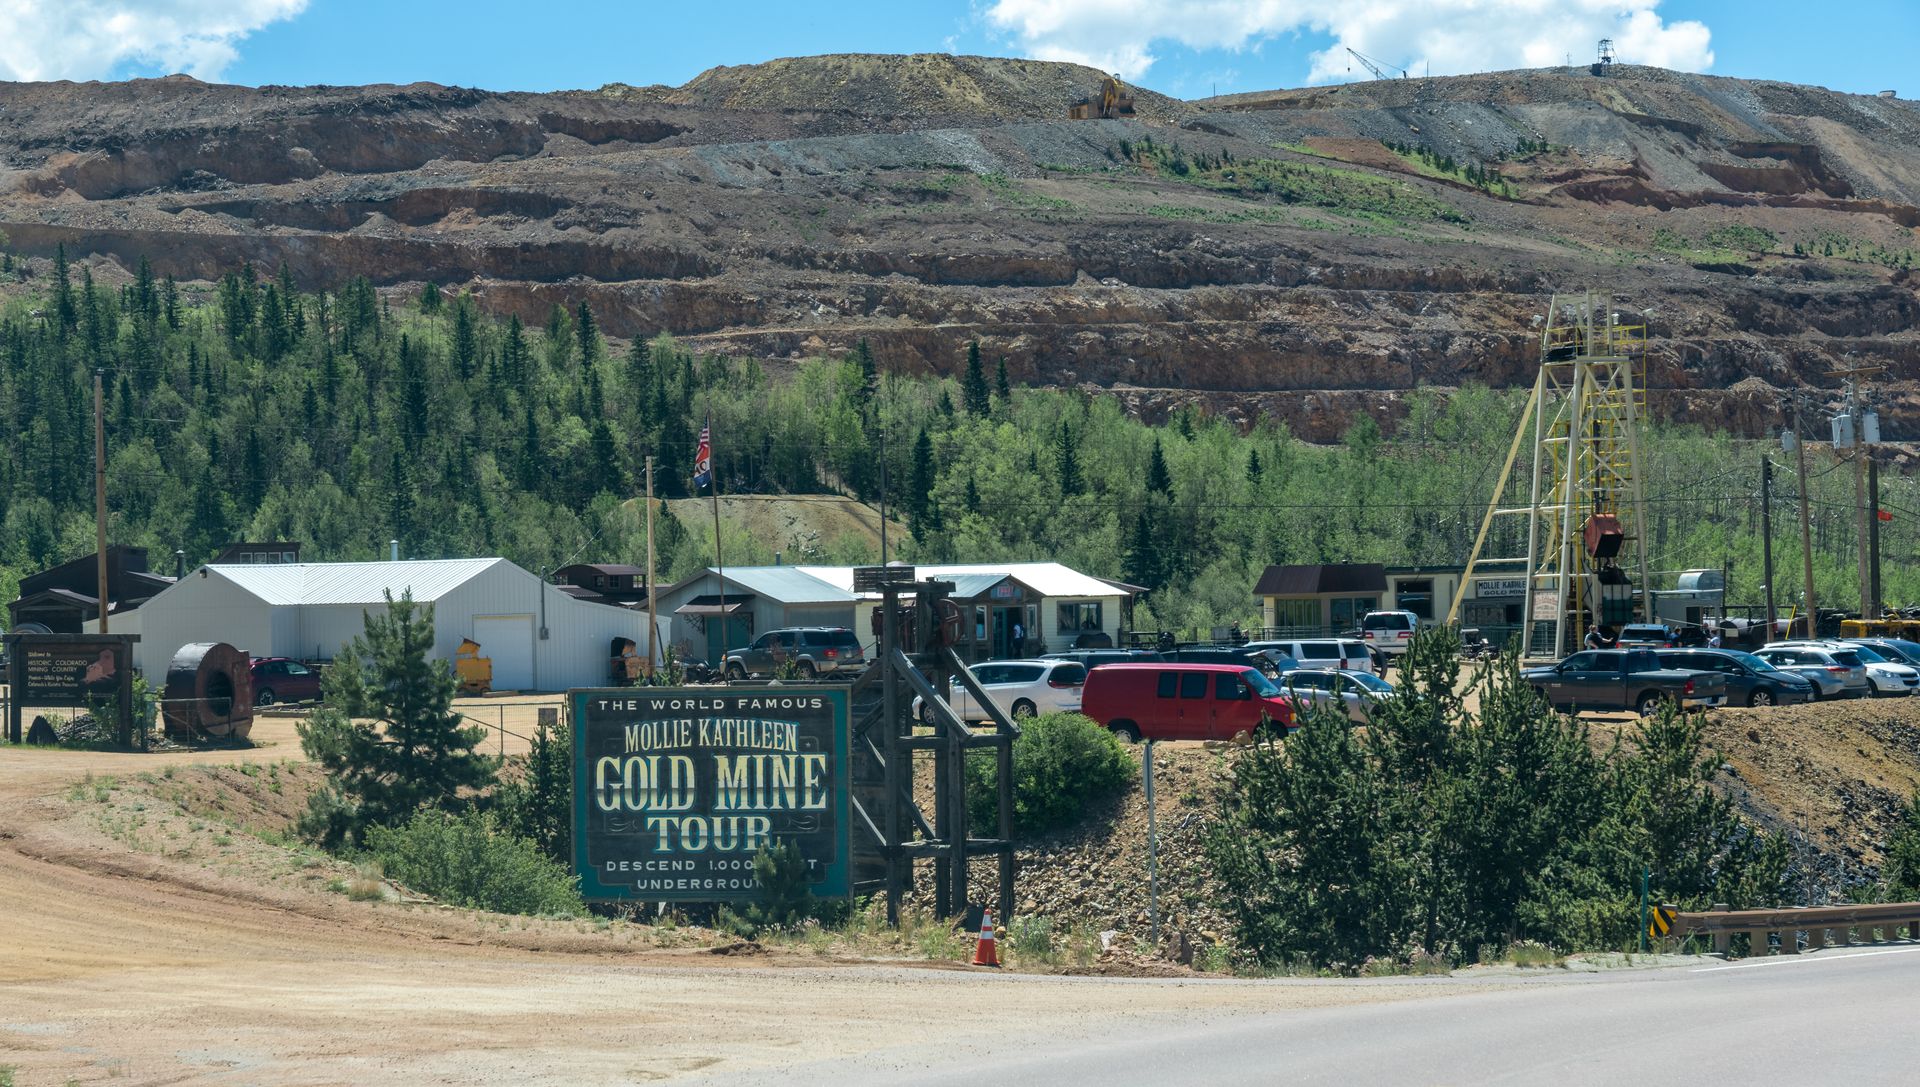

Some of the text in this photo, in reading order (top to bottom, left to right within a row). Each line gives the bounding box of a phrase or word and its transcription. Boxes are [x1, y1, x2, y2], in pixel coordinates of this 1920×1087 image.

[1479, 581, 1526, 589] MOLLIE KATHLE
[599, 698, 823, 711] THE WORLD FAMOUS
[625, 718, 798, 753] MOLLIE KATHLEEN
[596, 753, 828, 811] GOLD MINE
[647, 816, 774, 852] TOUR
[606, 860, 696, 872] DESCEND
